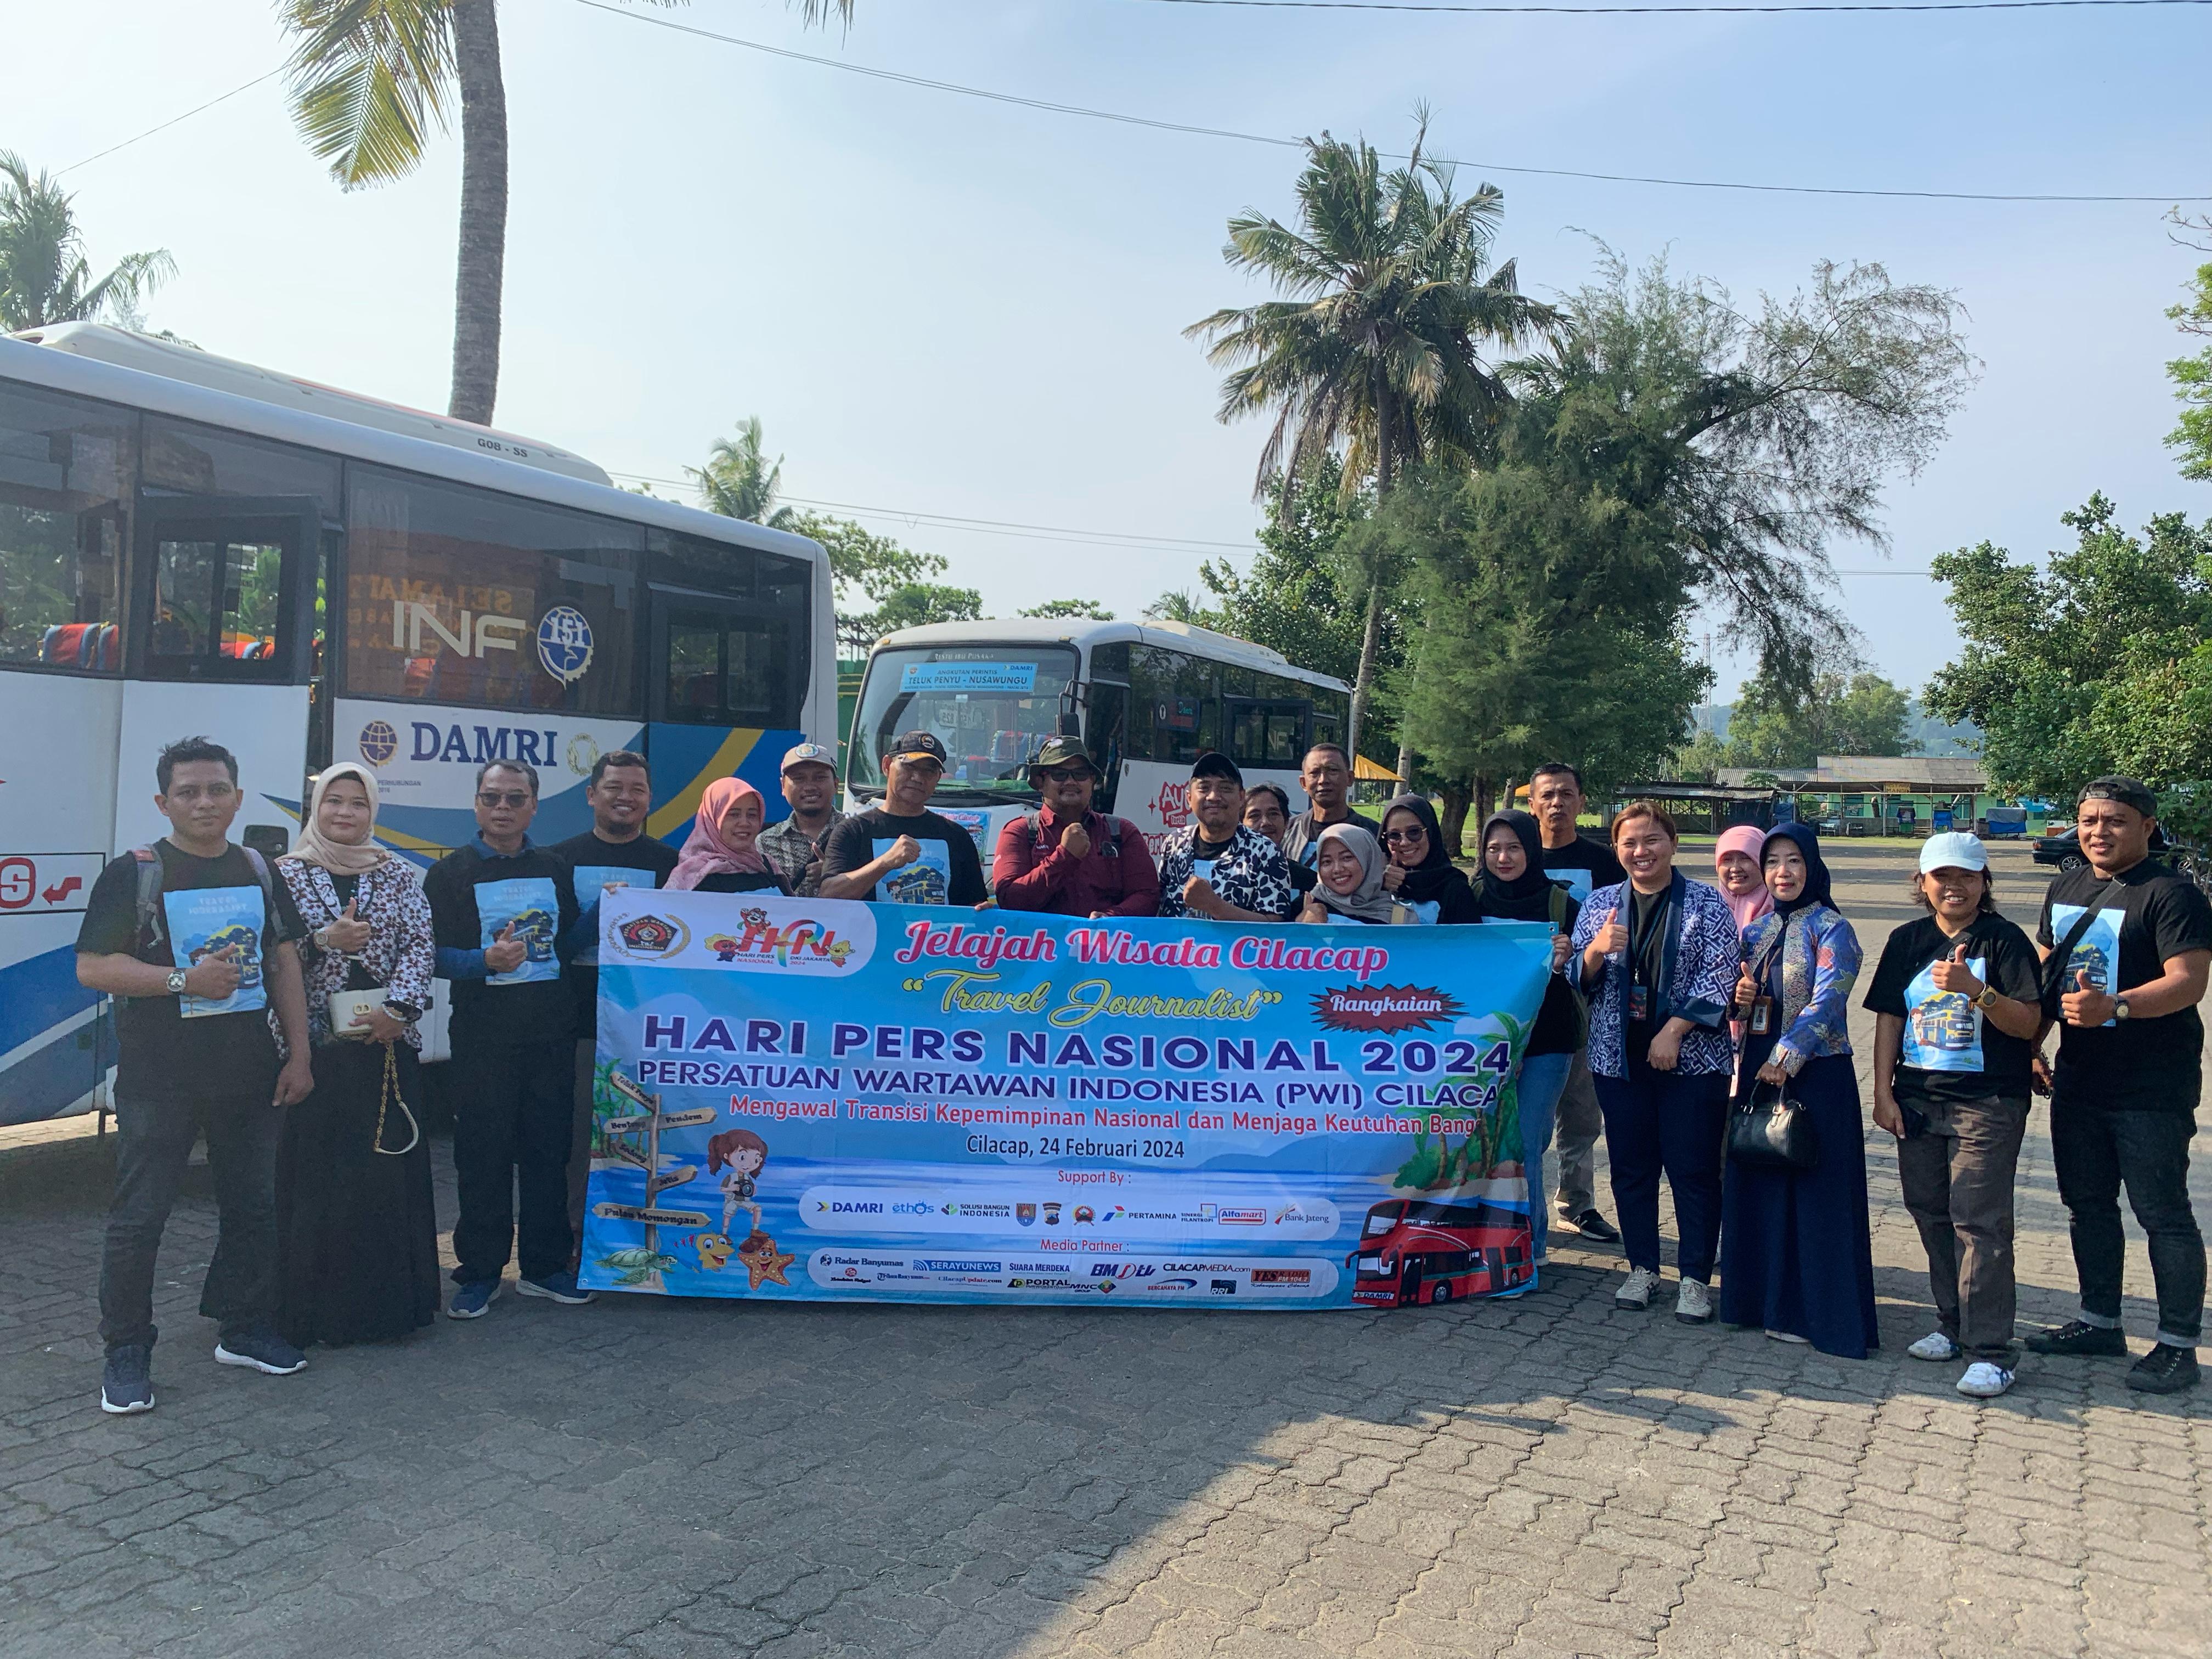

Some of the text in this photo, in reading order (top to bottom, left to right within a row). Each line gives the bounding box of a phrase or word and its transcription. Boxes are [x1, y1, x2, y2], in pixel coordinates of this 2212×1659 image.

[513, 447, 527, 457] SS
[550, 617, 586, 646] 151
[969, 676, 1028, 685] NUSAWUNGU
[410, 722, 558, 767] DAMRI
[896, 922, 1388, 981] Jelajah Wisata Cilacap
[1330, 995, 1442, 1017] Rangkaian
[644, 1015, 1510, 1074] HARI PERS NASIONAL 2024
[639, 1060, 1504, 1109] PERSATUAN WARTAWAN INDONESIA (PWI) CILACA
[730, 1095, 837, 1120] Mengawal
[846, 1099, 927, 1121] Transisi
[935, 1103, 1085, 1126] Kepemimpinan
[1094, 1108, 1180, 1128] Nasional
[1188, 1111, 1224, 1129] dan
[1233, 1111, 1317, 1135] Menjaga
[1325, 1113, 1422, 1133] Keutuhan
[967, 1135, 1184, 1158] Cilacap, 24 Februari 2024
[1058, 1170, 1105, 1186] Support
[1110, 1172, 1125, 1186] By
[832, 1201, 883, 1213] DAMRI
[637, 1212, 698, 1226] Momongan
[1305, 1215, 1329, 1223] Jateng
[1041, 1239, 1077, 1251] Media
[1081, 1240, 1124, 1252] Partner
[834, 1257, 904, 1268] Radar Banyumas
[930, 1261, 999, 1271] SERAYUNEWS
[1009, 1263, 1070, 1272] SUARA MERDEKA
[1163, 1263, 1251, 1272] CILACAPMEDIA.com
[1363, 1291, 1392, 1300] DAMRI
